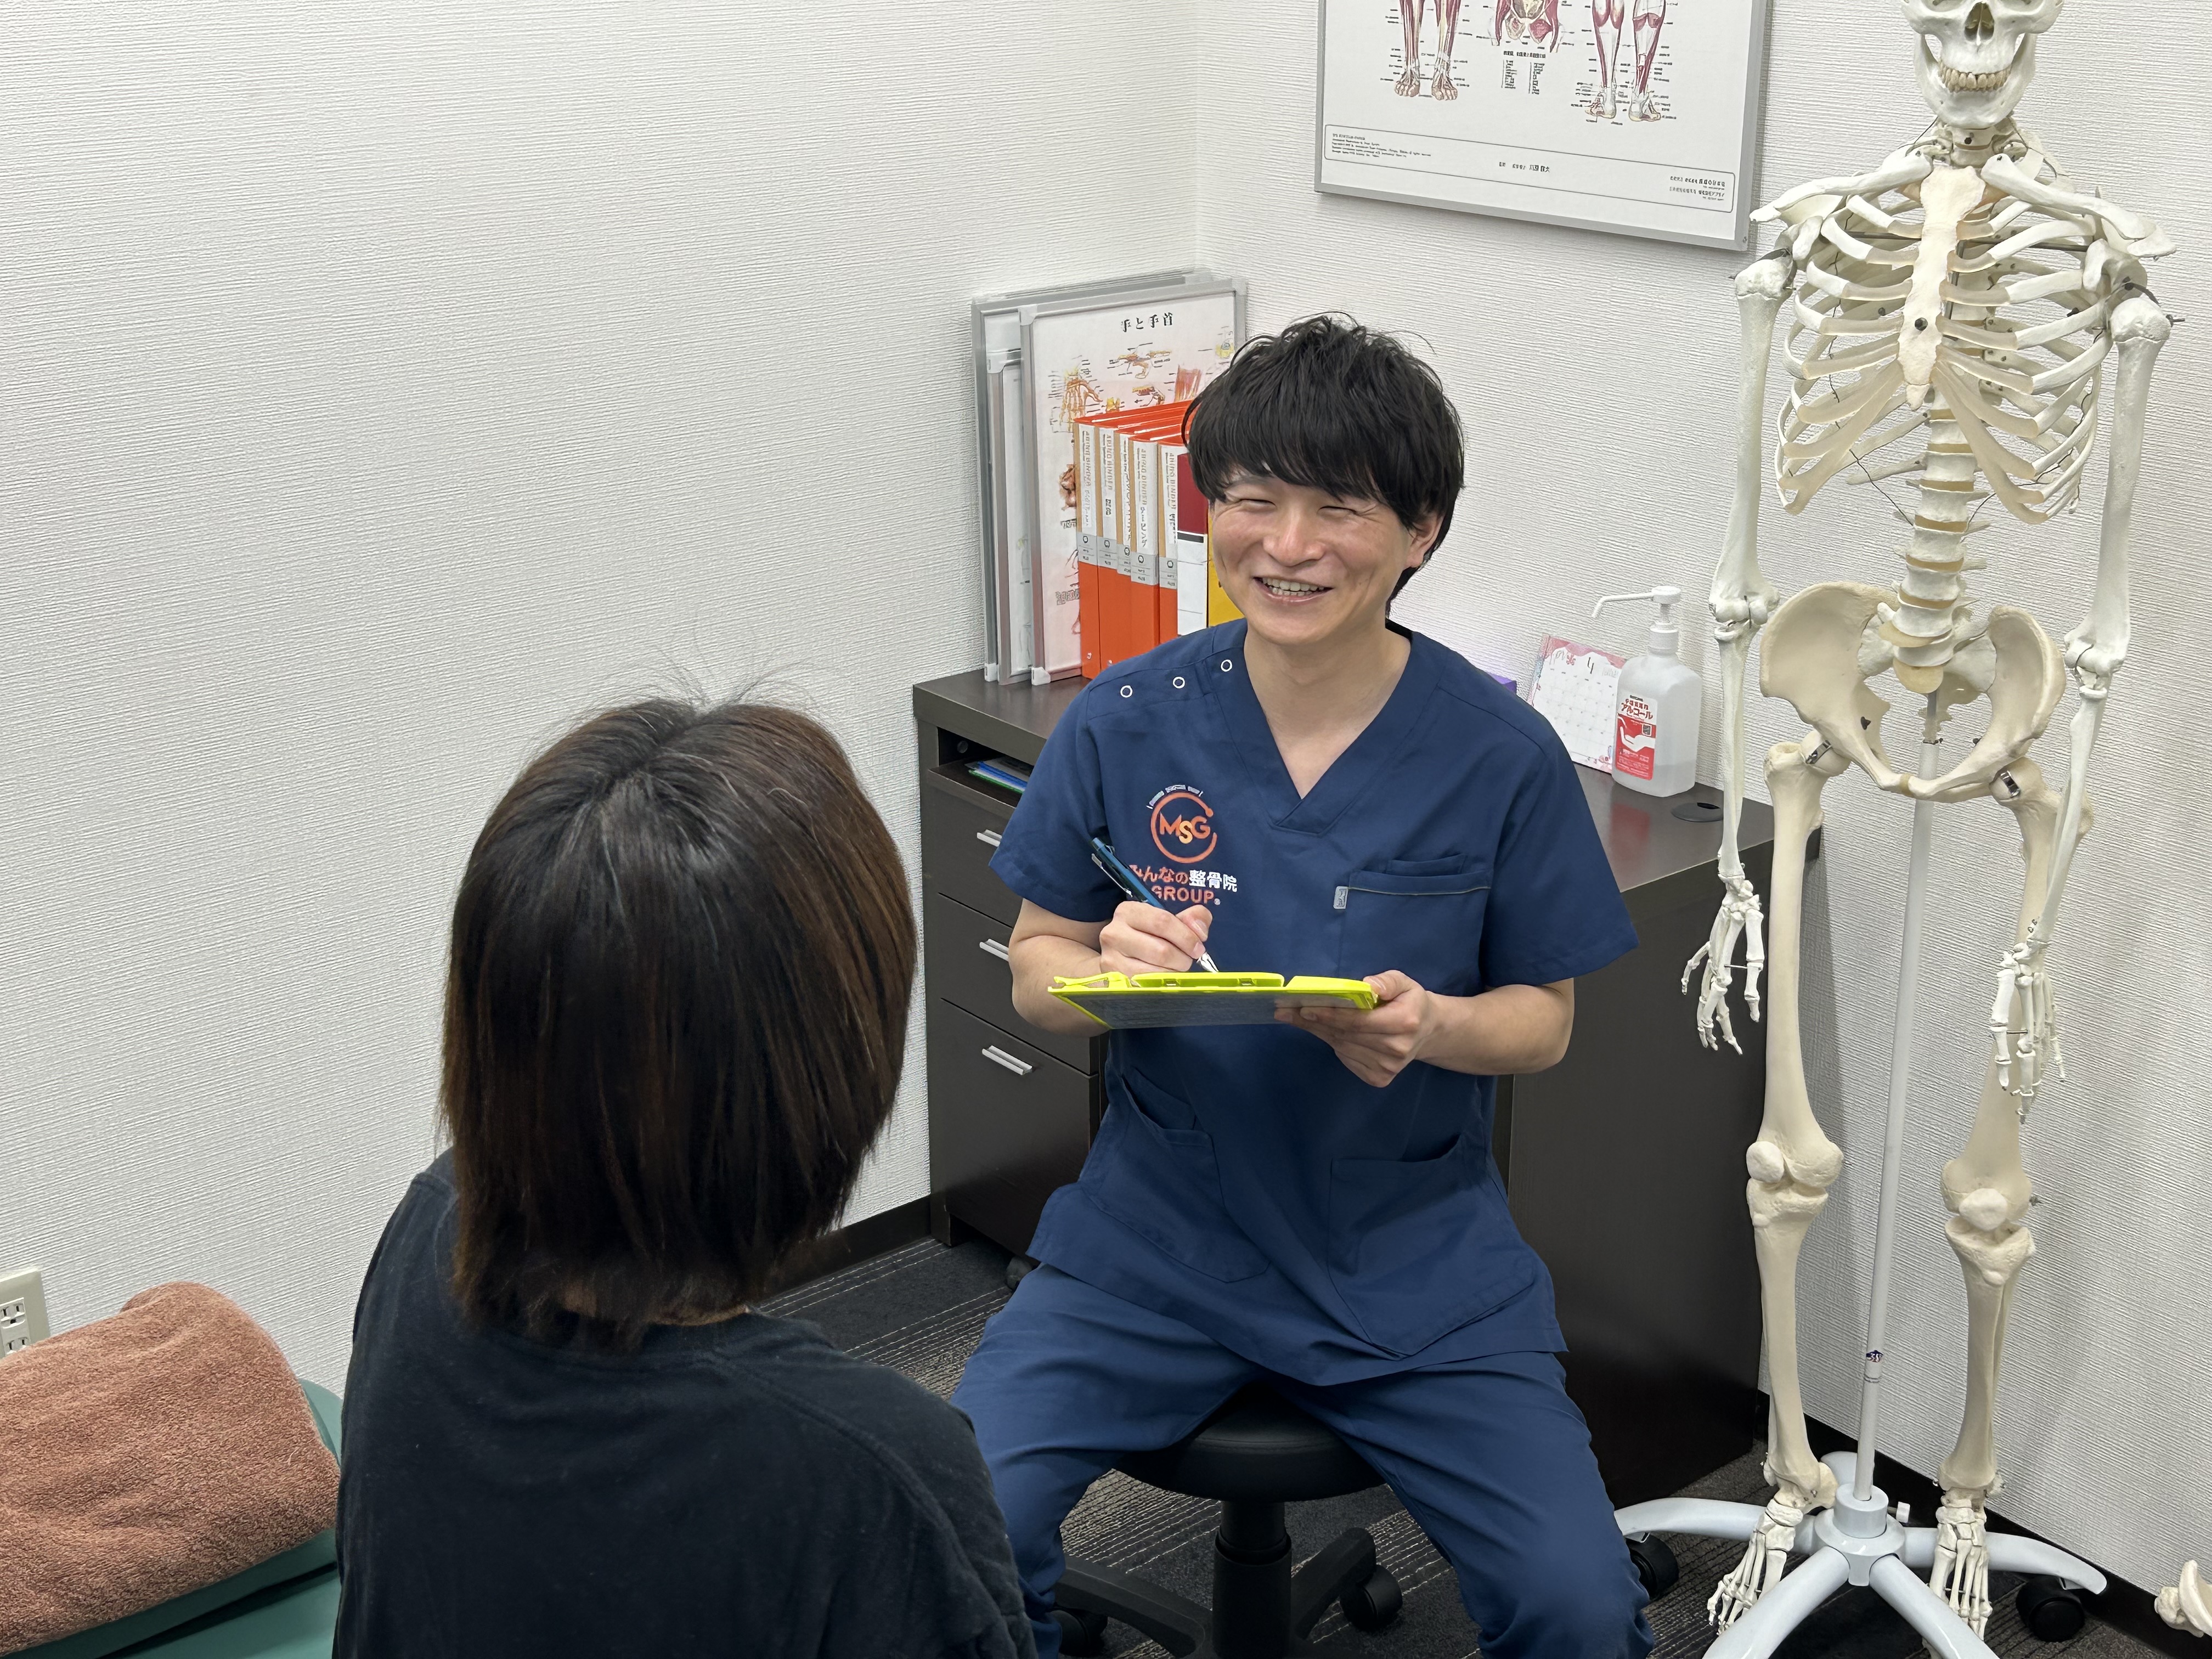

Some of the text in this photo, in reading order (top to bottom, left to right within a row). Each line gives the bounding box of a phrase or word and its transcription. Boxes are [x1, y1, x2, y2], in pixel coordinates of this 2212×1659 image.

[1120, 312, 1173, 332] 手と手首
[1621, 702, 1654, 720] アルコール
[1159, 811, 1211, 844] MSG
